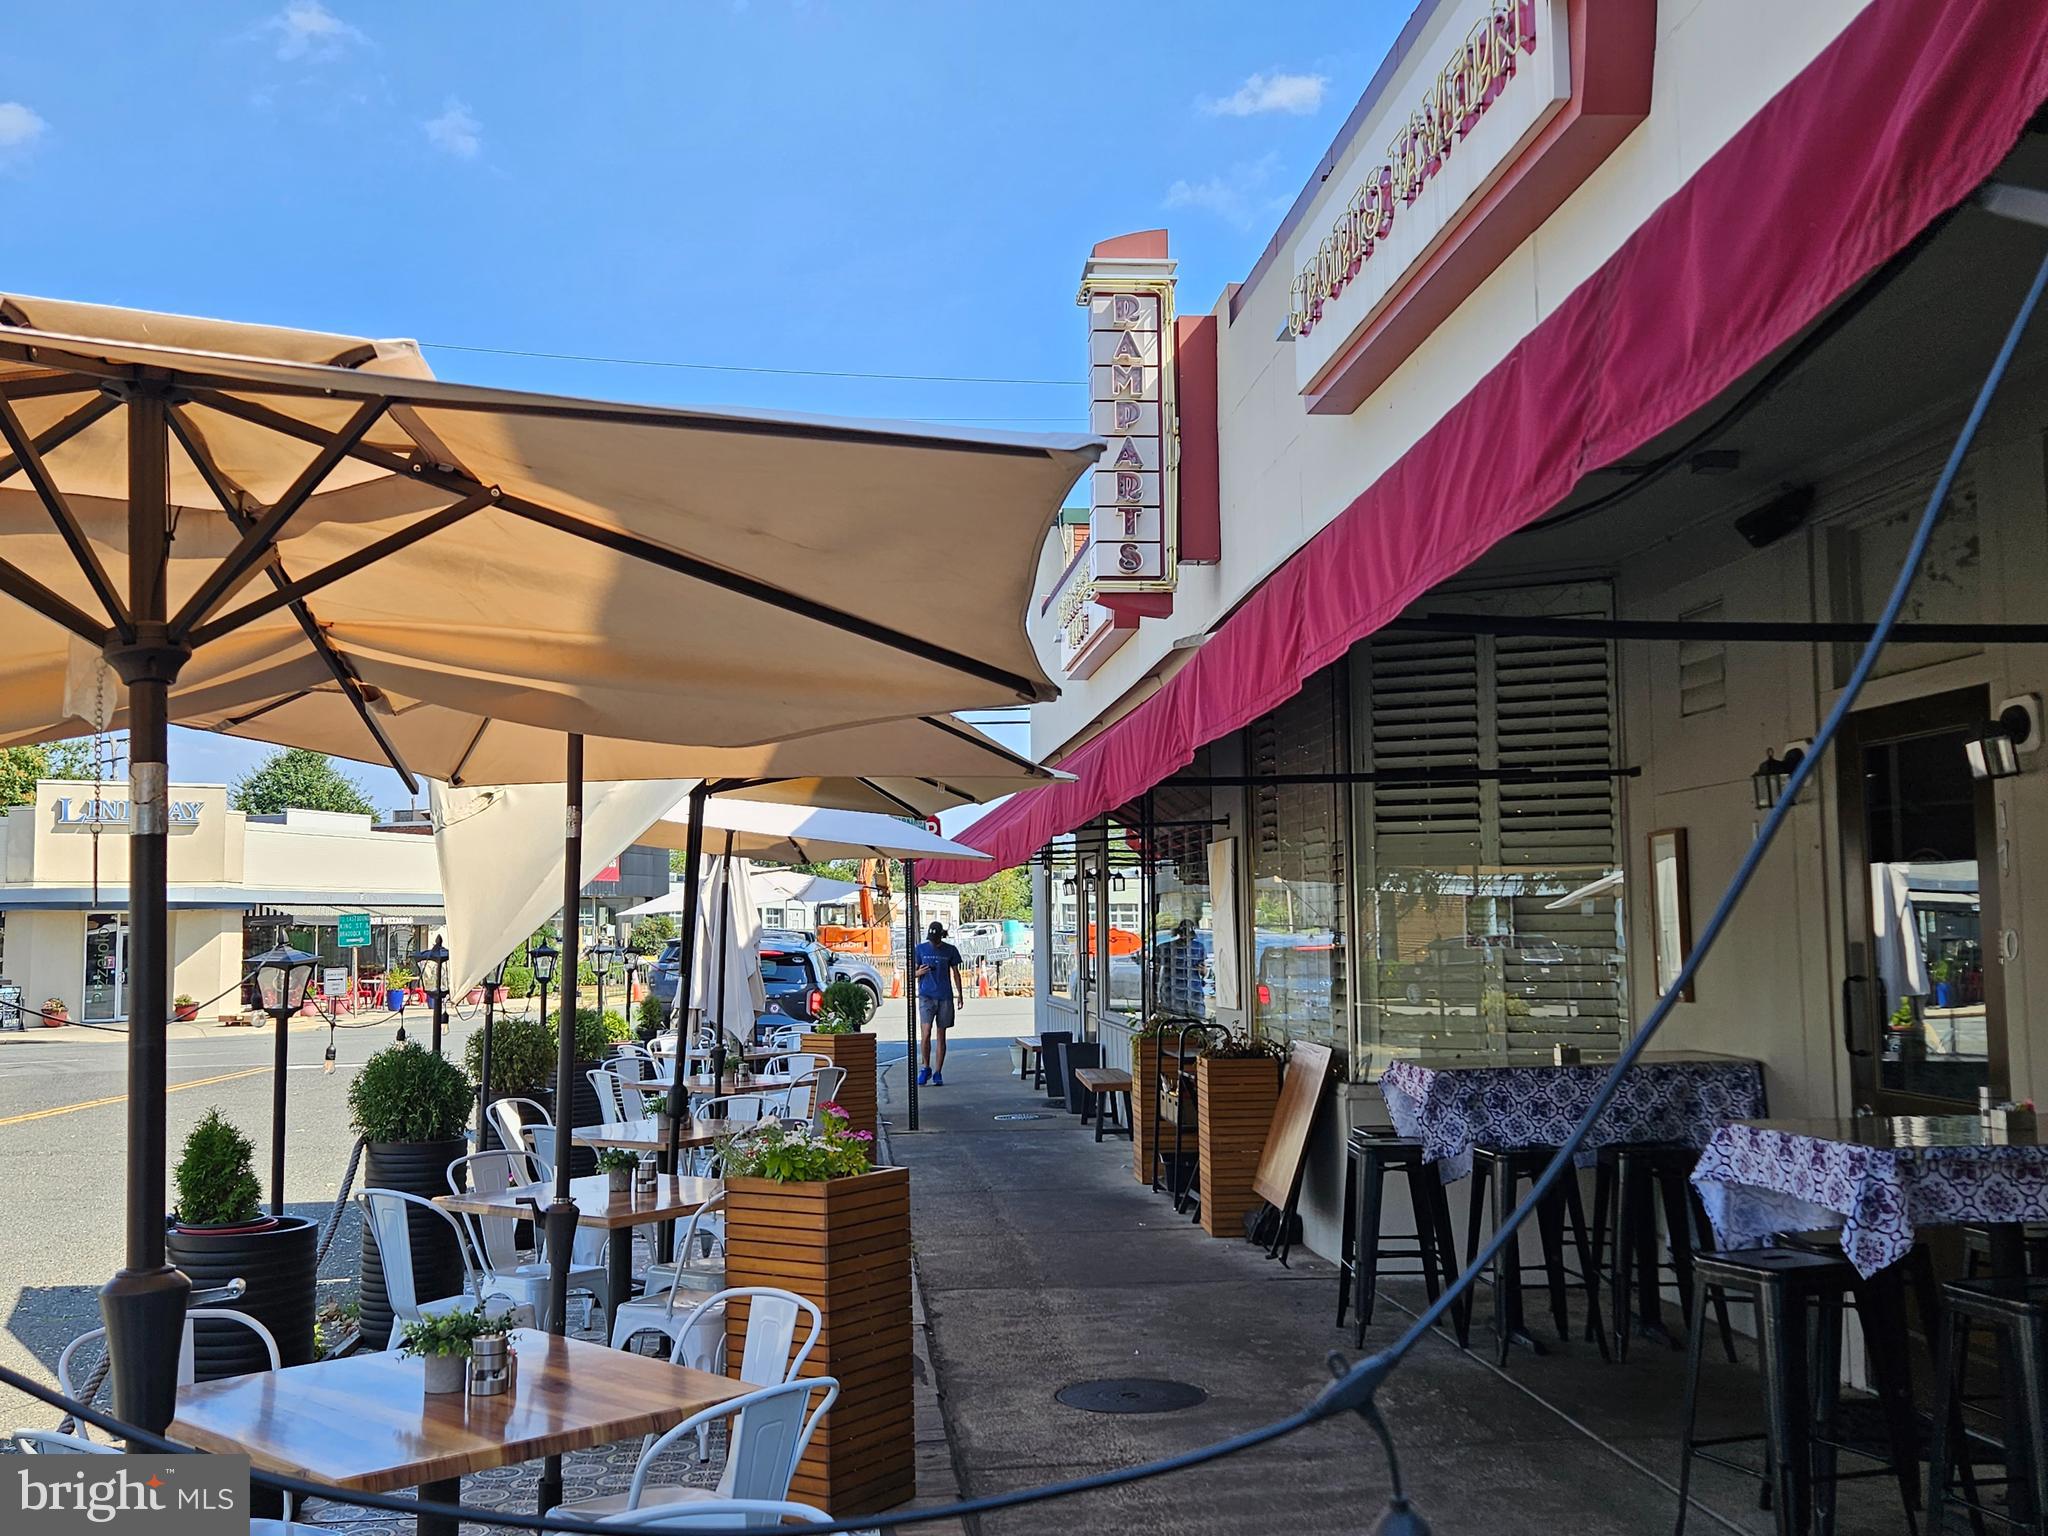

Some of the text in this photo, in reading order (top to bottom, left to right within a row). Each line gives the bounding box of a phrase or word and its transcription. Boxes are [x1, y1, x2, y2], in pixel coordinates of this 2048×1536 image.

[1288, 165, 1394, 337] SPORTS
[1112, 294, 1145, 575] RAMPARTS
[58, 796, 205, 823] LINAY
